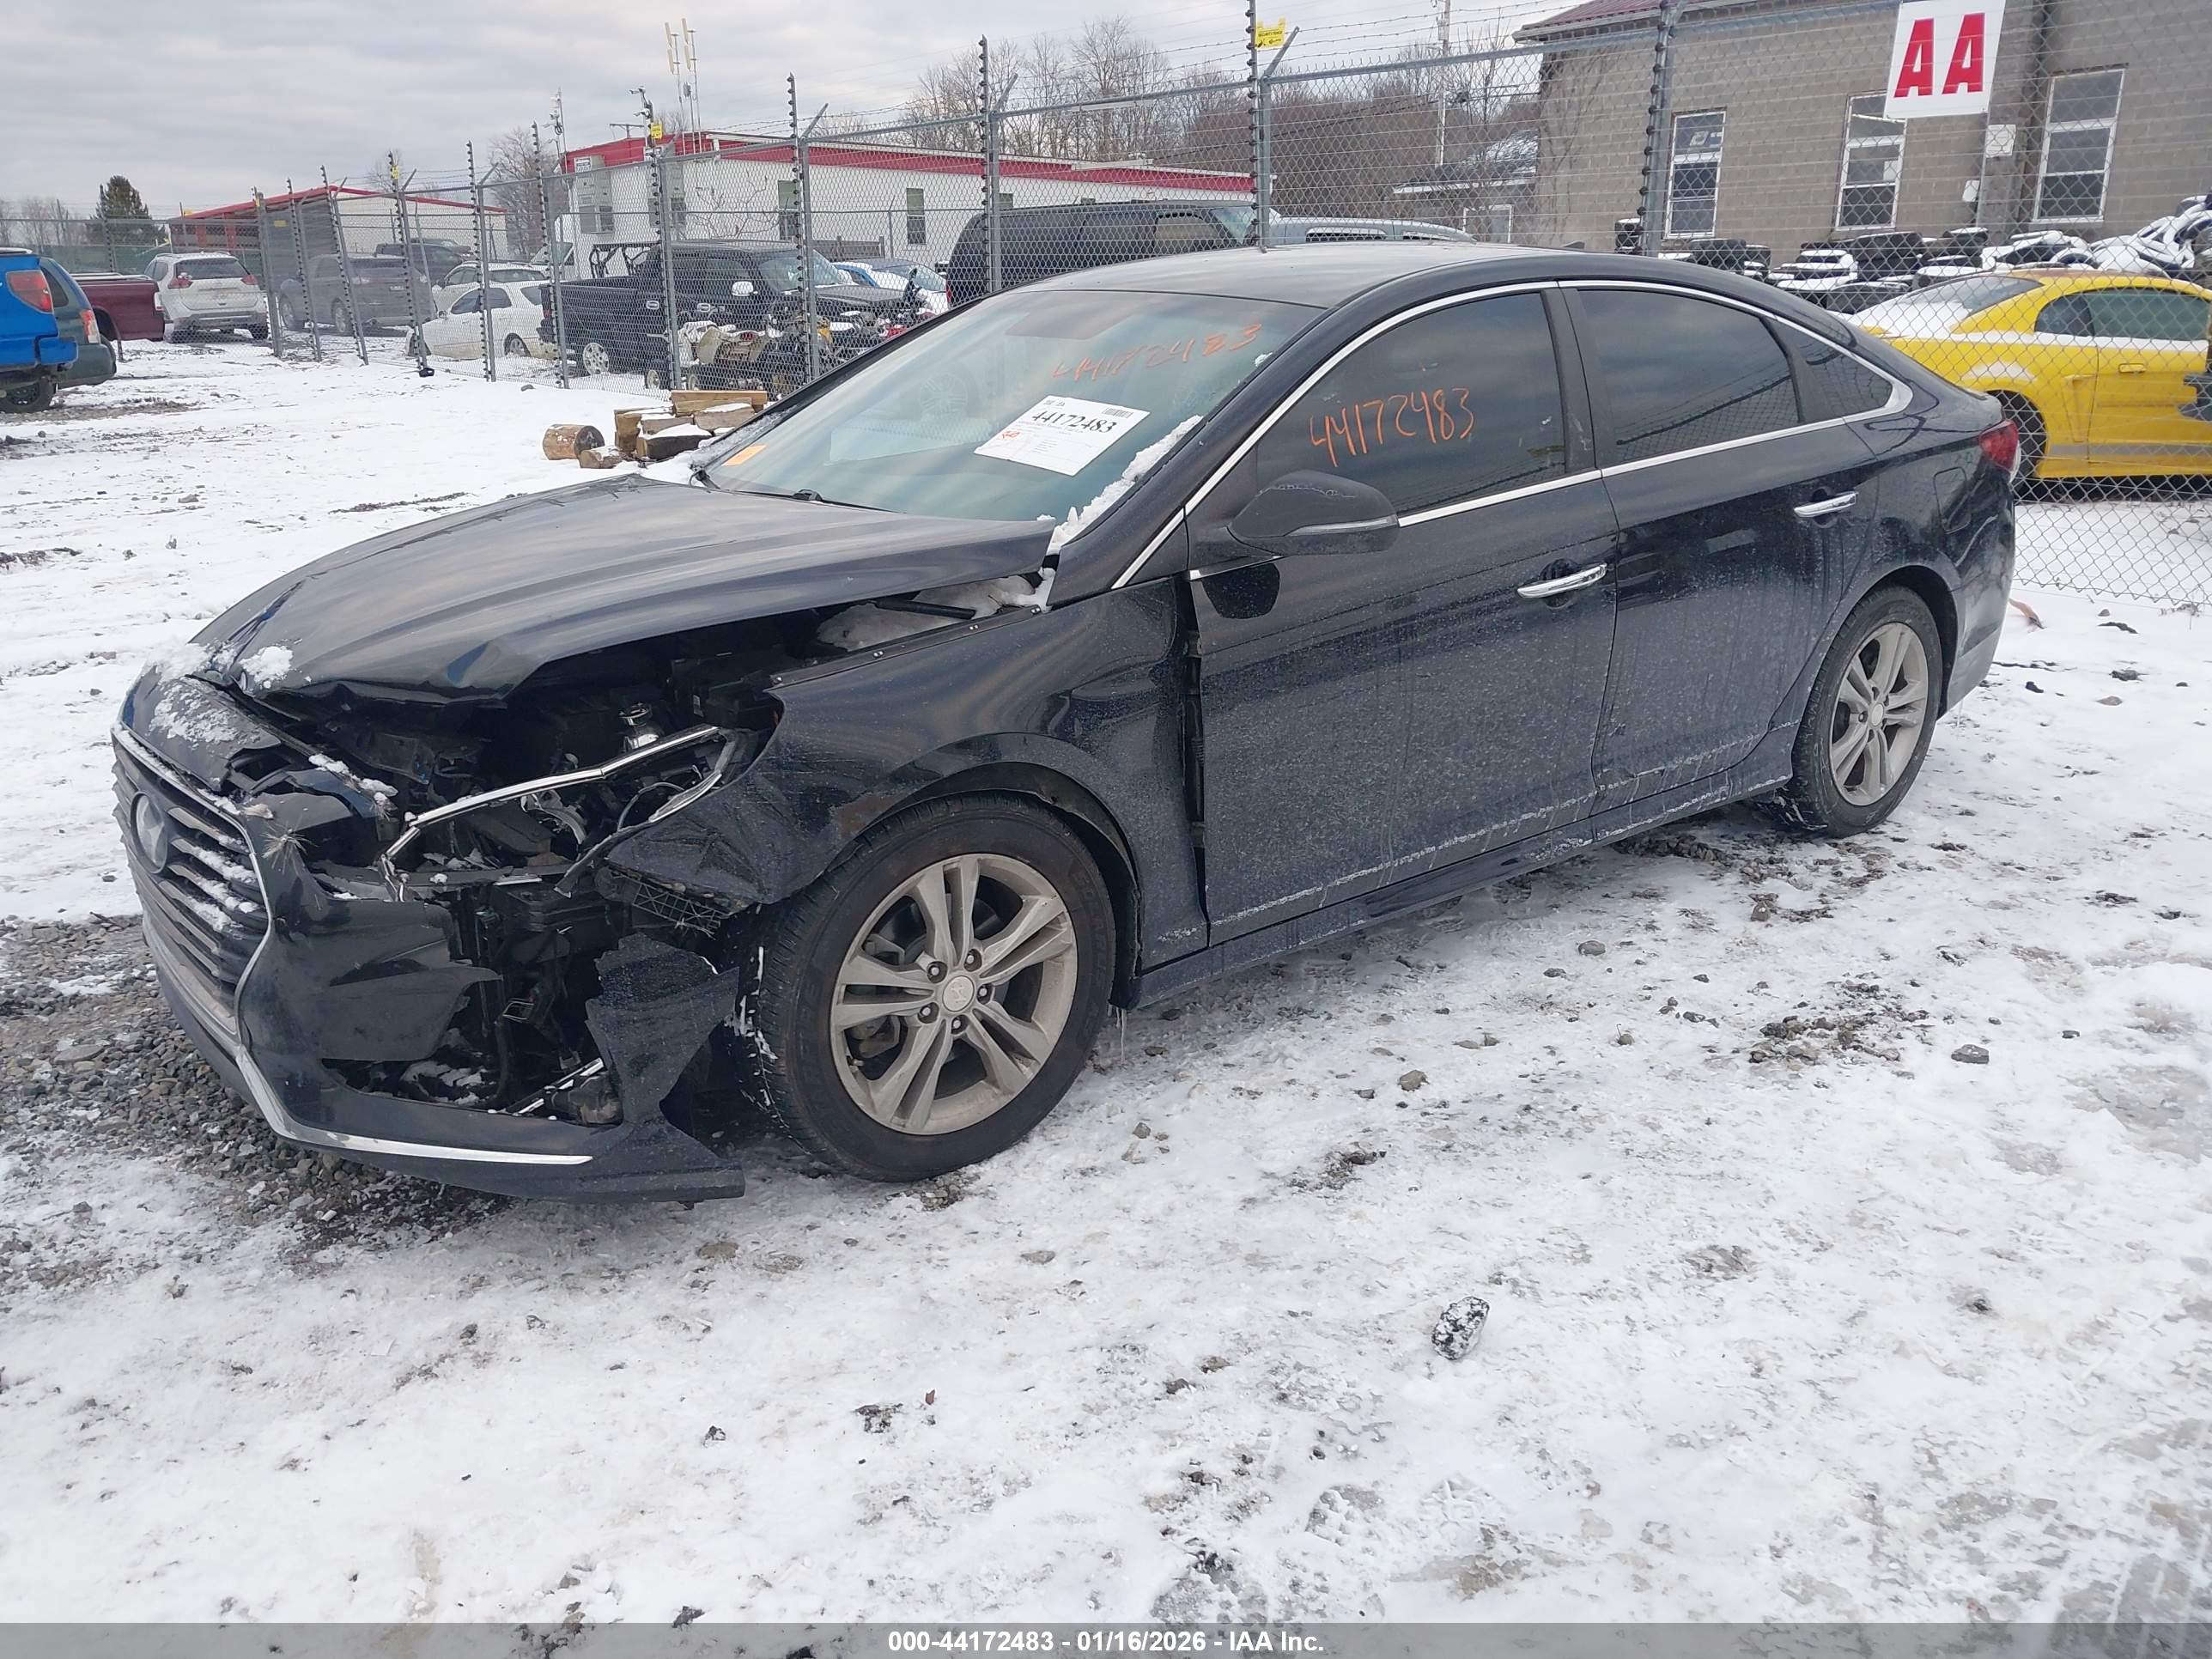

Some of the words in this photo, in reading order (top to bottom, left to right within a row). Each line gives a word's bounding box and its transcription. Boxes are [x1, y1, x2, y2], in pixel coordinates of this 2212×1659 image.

[1893, 13, 1985, 98] AA
[1031, 410, 1120, 434] 44172483
[1309, 387, 1475, 468] 44172483
